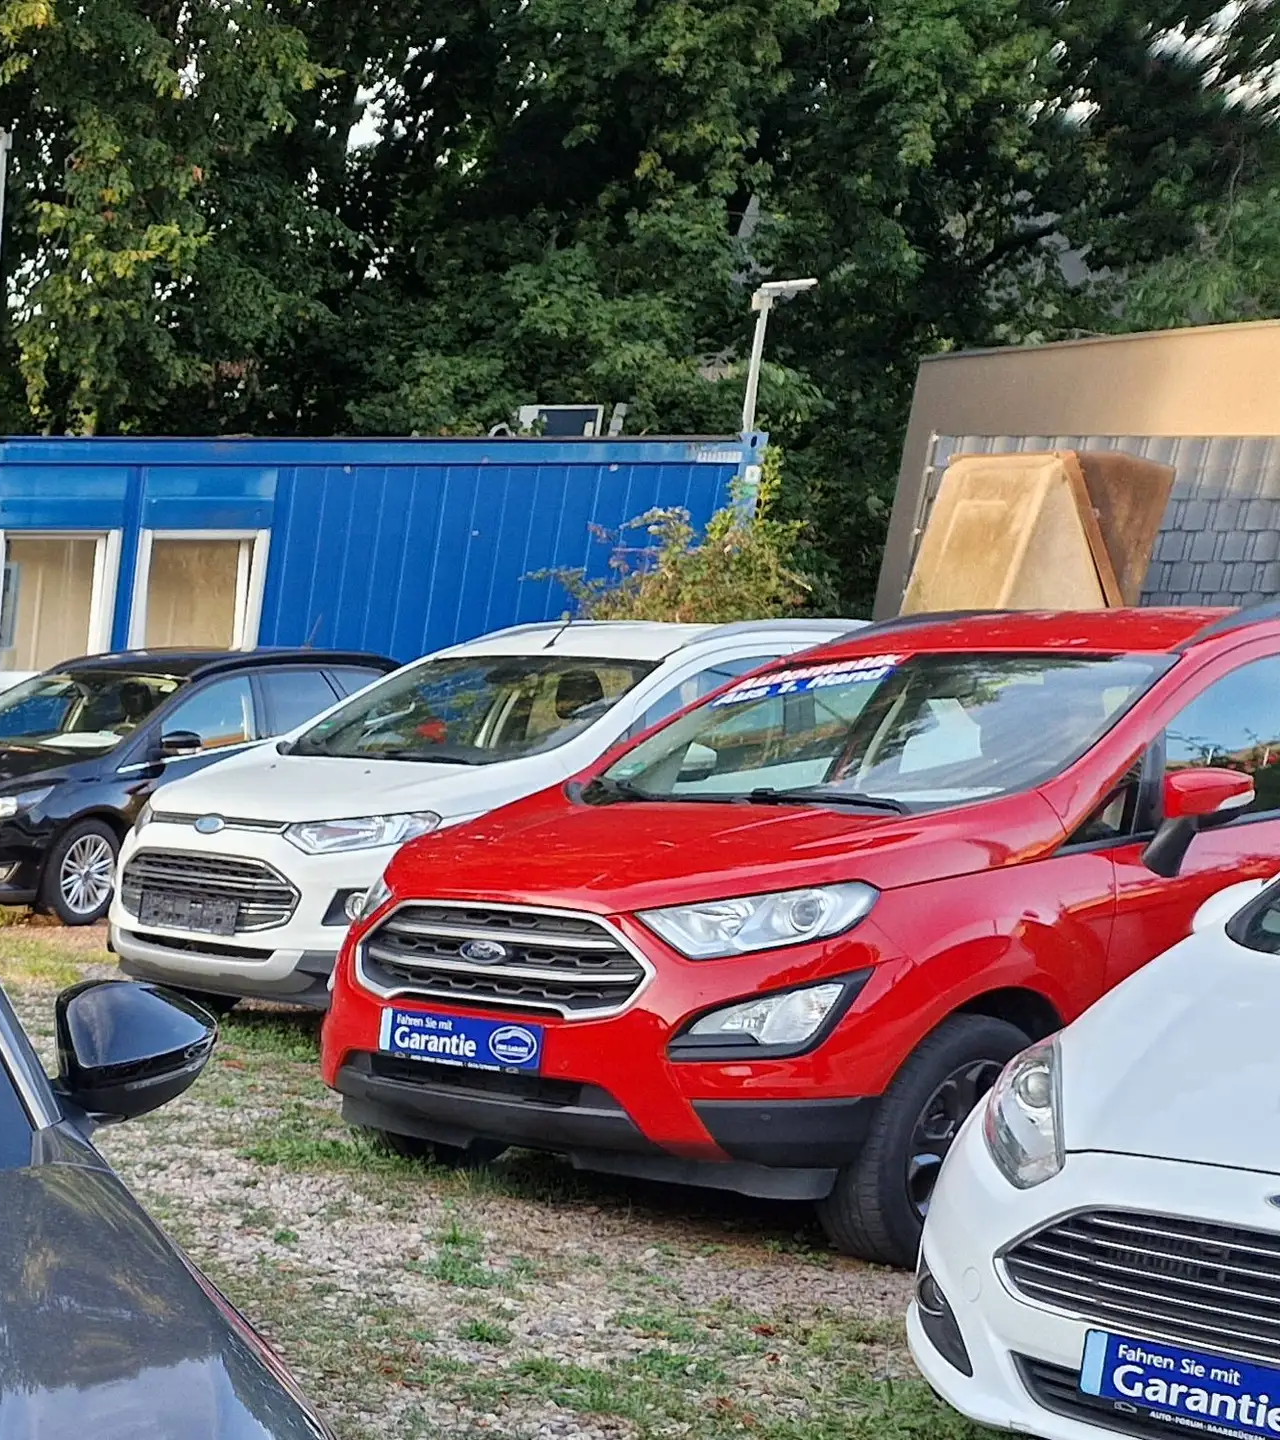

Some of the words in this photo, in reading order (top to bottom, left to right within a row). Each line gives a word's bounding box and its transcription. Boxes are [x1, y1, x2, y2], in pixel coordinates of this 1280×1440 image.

[396, 1013, 424, 1028] Fahren
[425, 1016, 438, 1030] Sie
[438, 1019, 453, 1031] mit
[394, 1026, 477, 1057] Garantie
[1118, 1344, 1175, 1370] Fahren
[1180, 1358, 1206, 1377] Sie
[1210, 1368, 1241, 1386] mit
